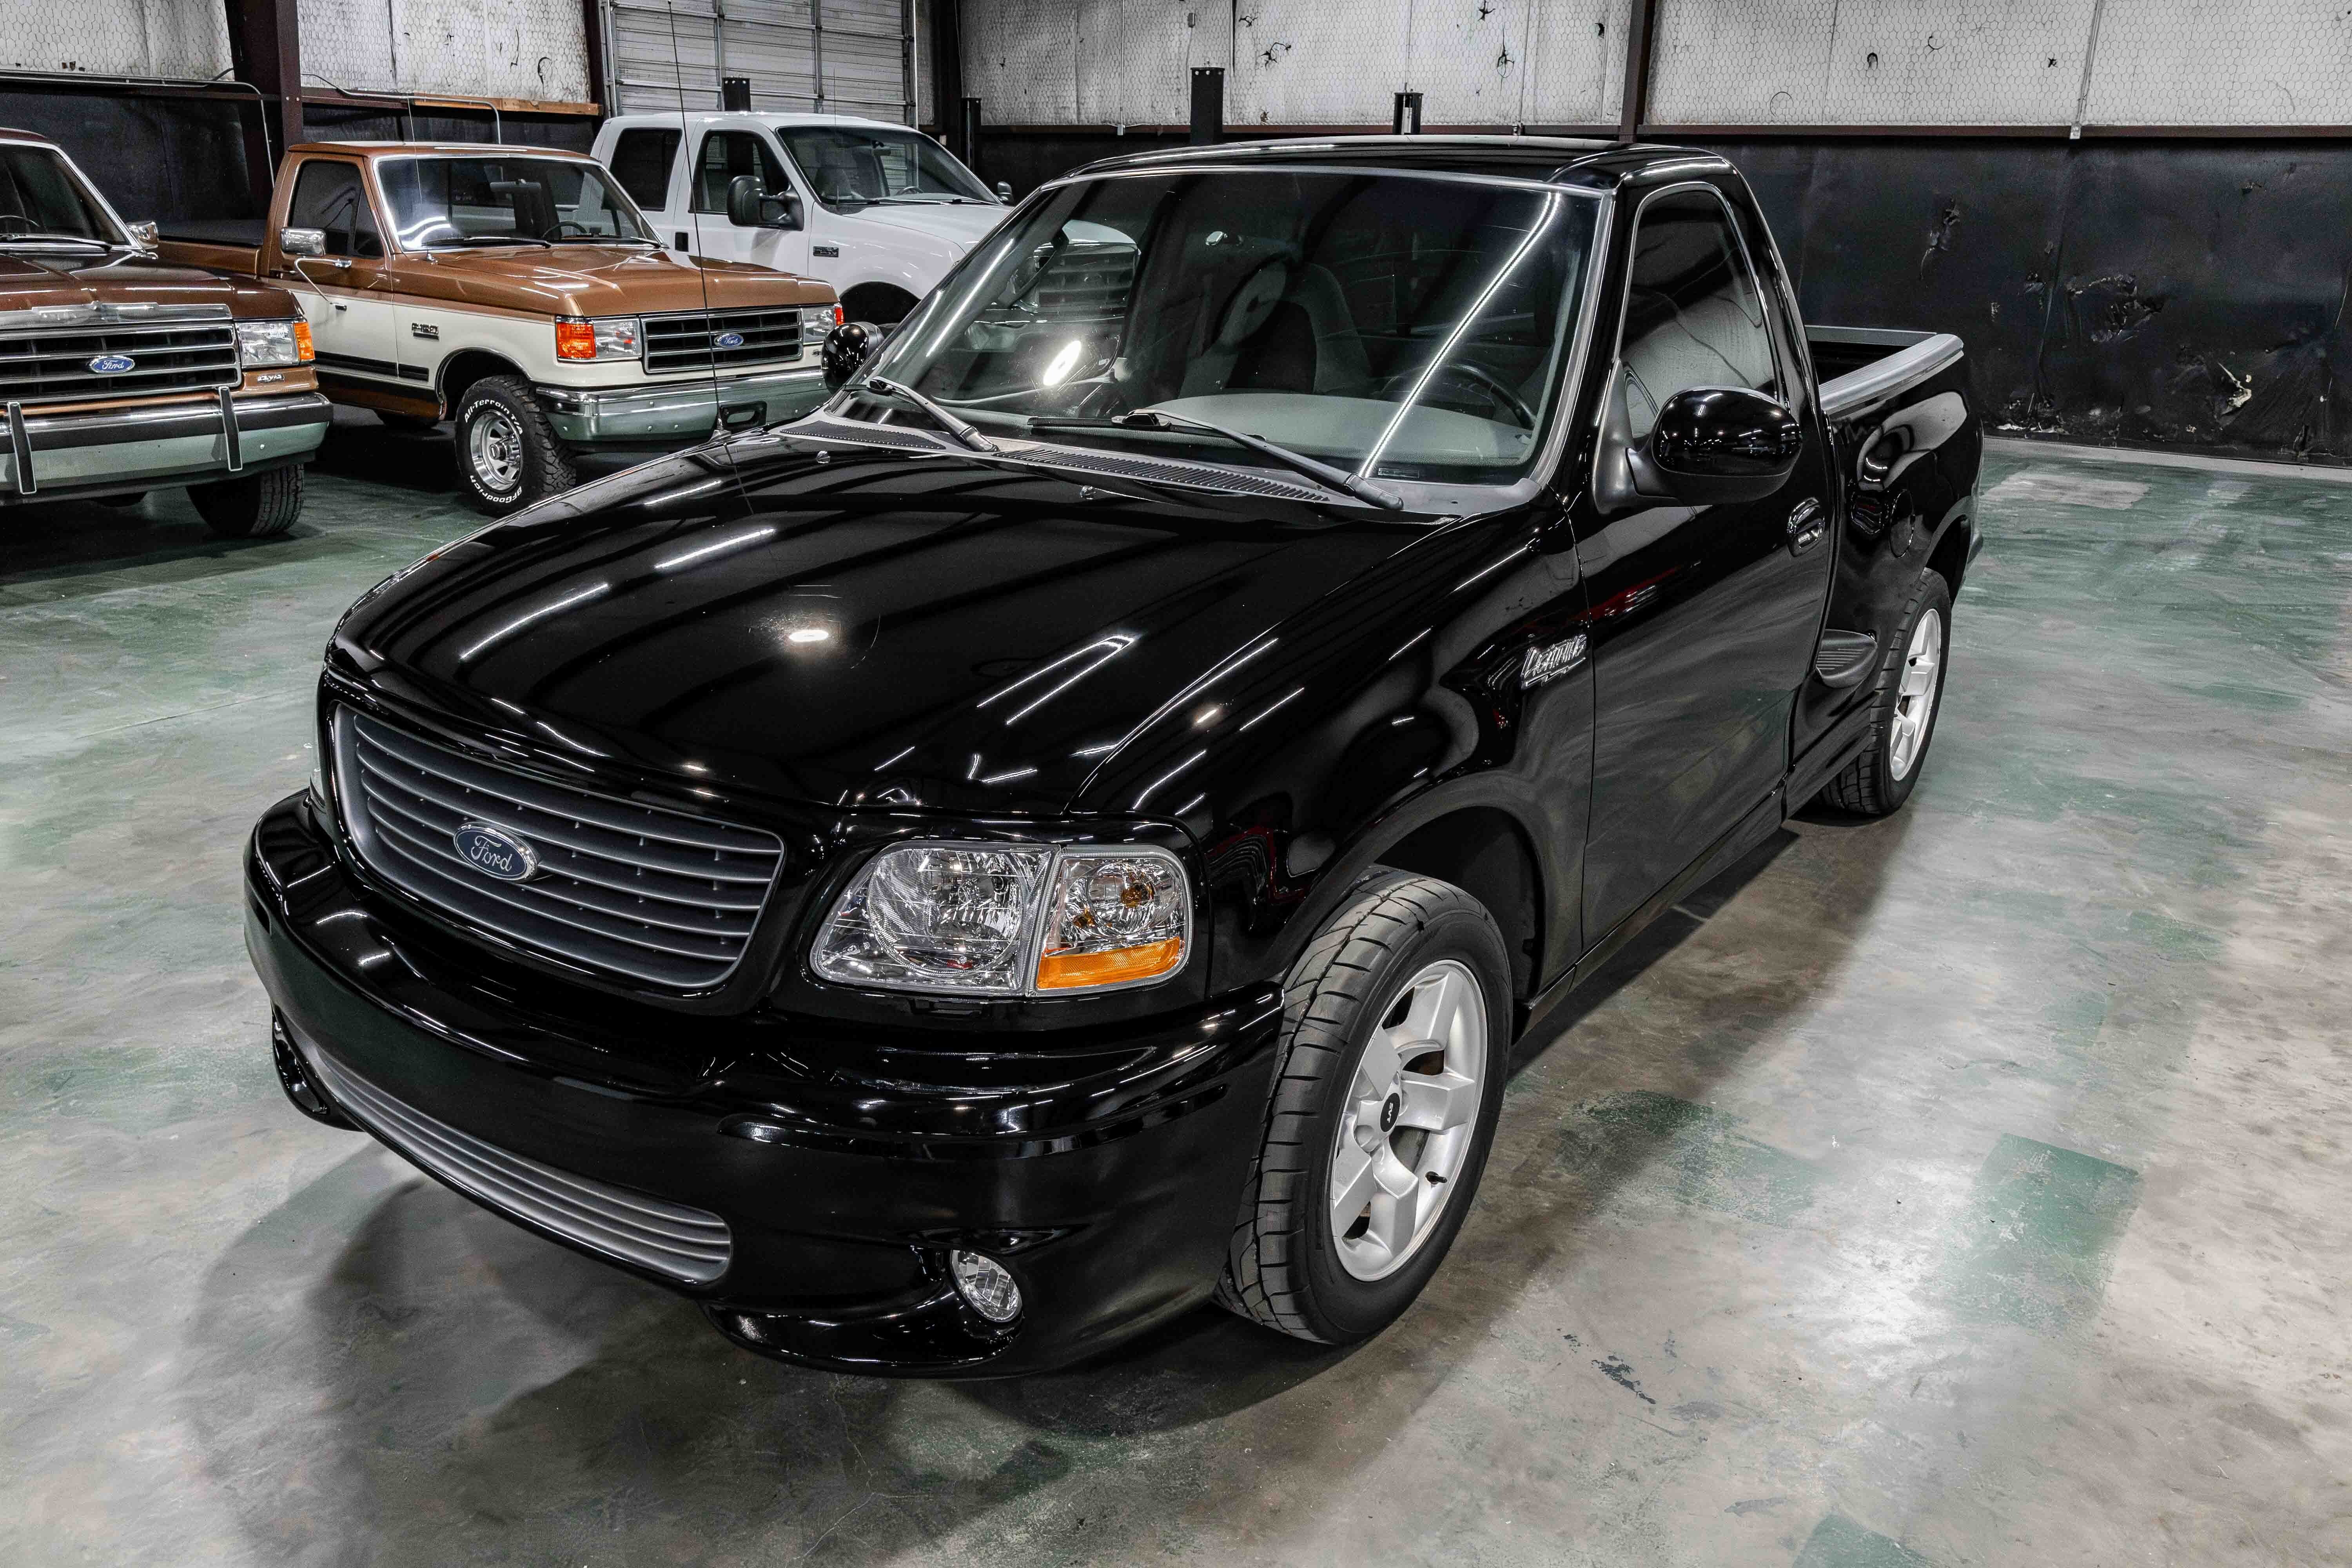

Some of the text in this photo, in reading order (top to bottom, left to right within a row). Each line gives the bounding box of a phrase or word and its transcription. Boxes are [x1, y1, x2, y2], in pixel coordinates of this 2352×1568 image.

[102, 360, 124, 370] Ford
[464, 399, 523, 435] All-Terrain T/A
[470, 475, 522, 503] BFGoodrich
[470, 835, 513, 872] Ford
